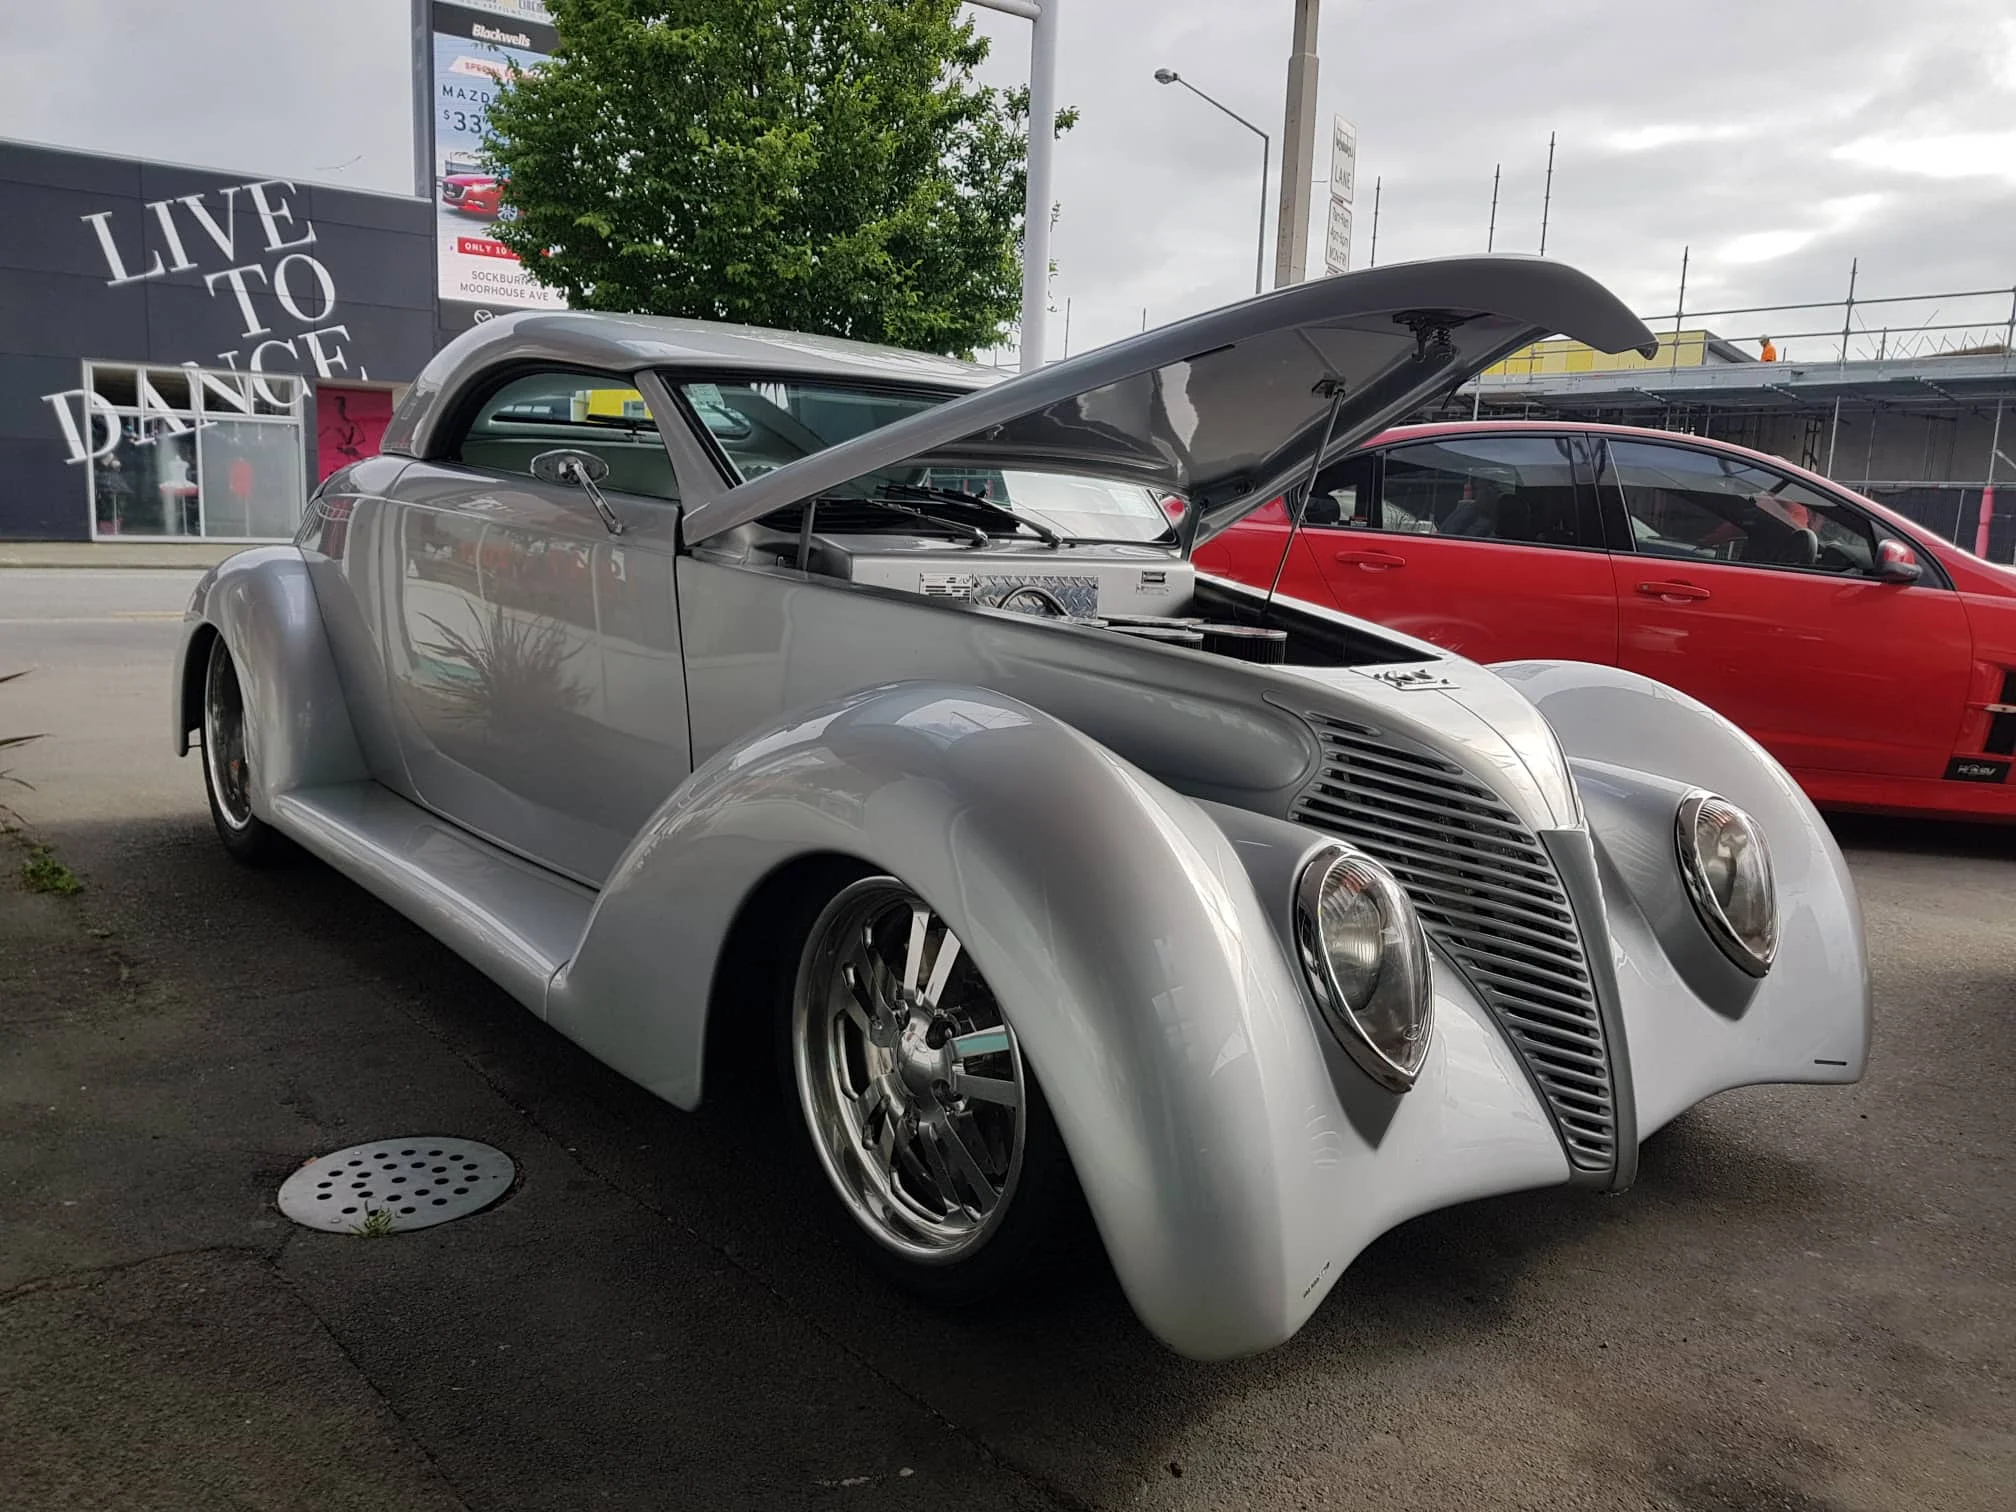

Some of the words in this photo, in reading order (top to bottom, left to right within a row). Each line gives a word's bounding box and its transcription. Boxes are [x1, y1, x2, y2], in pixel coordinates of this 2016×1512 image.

[472, 23, 530, 47] Blackwells
[1334, 164, 1351, 189] LANE
[80, 179, 318, 288] LIVE
[464, 242, 492, 253] ONLY
[496, 246, 507, 255] 10
[203, 253, 337, 339] TO
[460, 283, 526, 298] MOORHOUSE
[529, 290, 549, 301] AVE
[40, 325, 369, 464] DANCE
